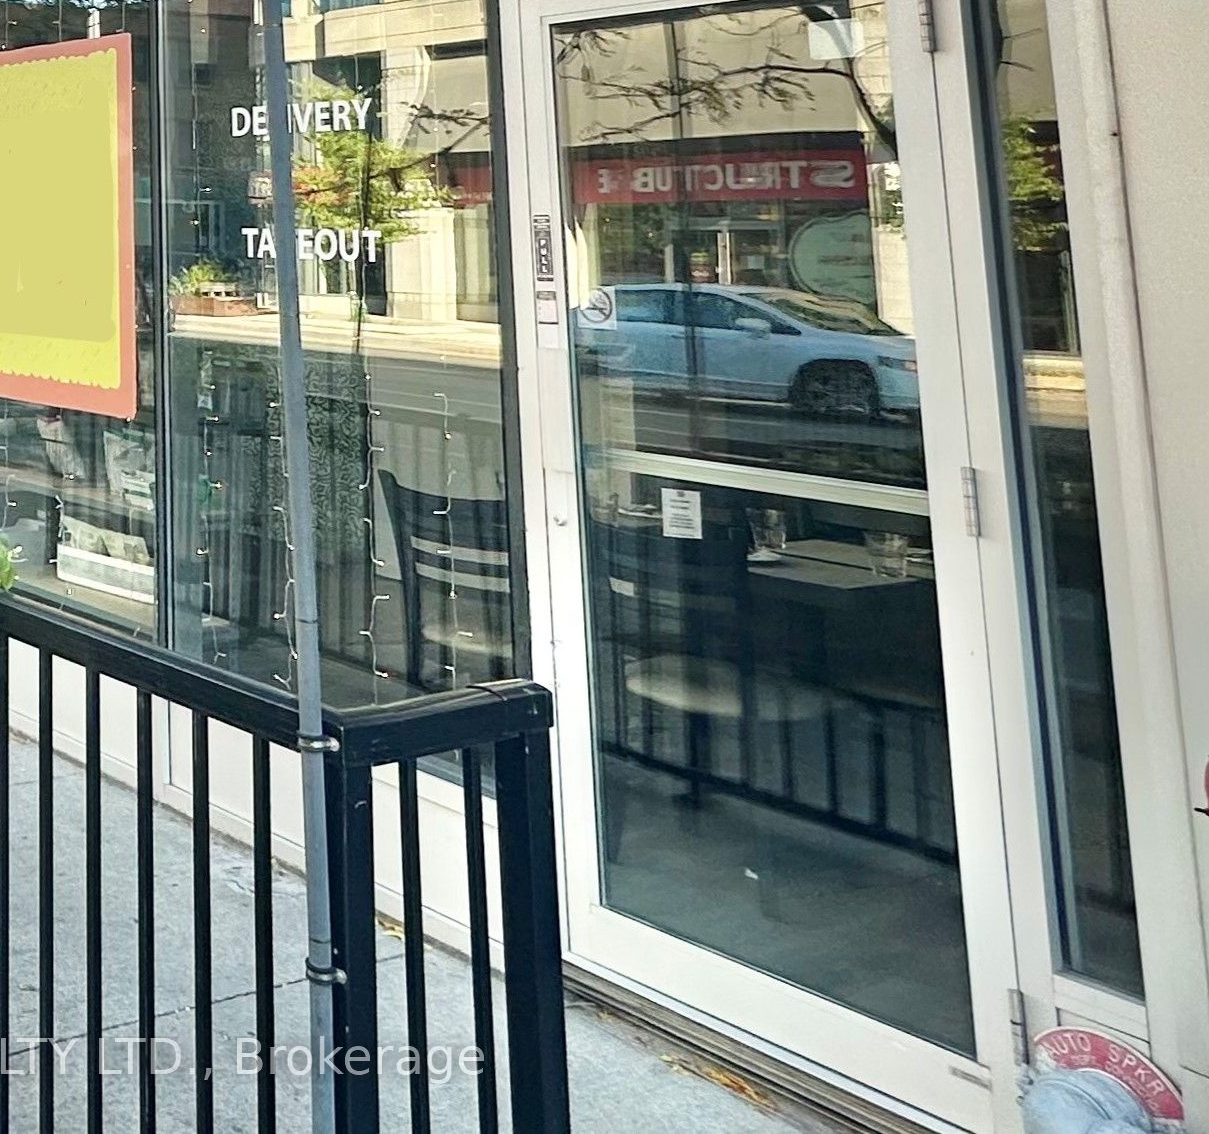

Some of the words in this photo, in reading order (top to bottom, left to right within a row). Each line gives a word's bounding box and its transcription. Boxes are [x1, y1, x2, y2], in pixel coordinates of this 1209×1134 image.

[230, 98, 373, 138] DEIVERY
[241, 227, 382, 263] TAEOUT
[538, 238, 549, 274] PULL
[1042, 1032, 1092, 1057] AUTO
[1107, 1043, 1166, 1097] SPKR
